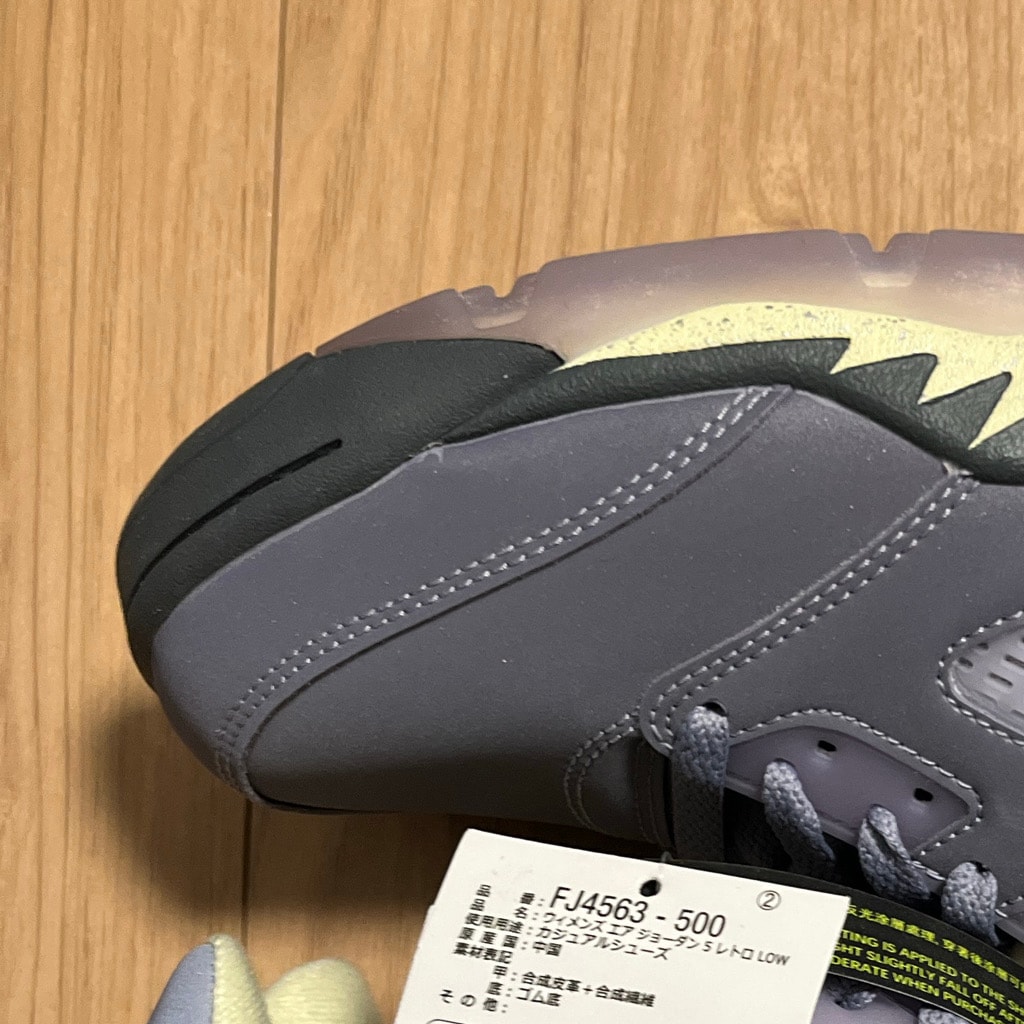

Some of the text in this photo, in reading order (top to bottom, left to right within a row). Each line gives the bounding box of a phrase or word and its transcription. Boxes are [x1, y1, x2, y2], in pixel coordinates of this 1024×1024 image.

[550, 886, 648, 923] FJ4563
[674, 909, 726, 938] 500
[716, 943, 754, 961] レトロ
[757, 950, 790, 966] LOW
[831, 955, 889, 979] DERATE
[892, 972, 940, 996] WHEN
[841, 929, 879, 947] TING
[882, 941, 897, 953] IS
[899, 948, 958, 977] APPLIED
[960, 972, 980, 988] TO
[981, 983, 1006, 1005] THE
[866, 950, 936, 980] SLIGHTLY
[939, 976, 970, 998] FALL
[972, 993, 997, 1010] OFF
